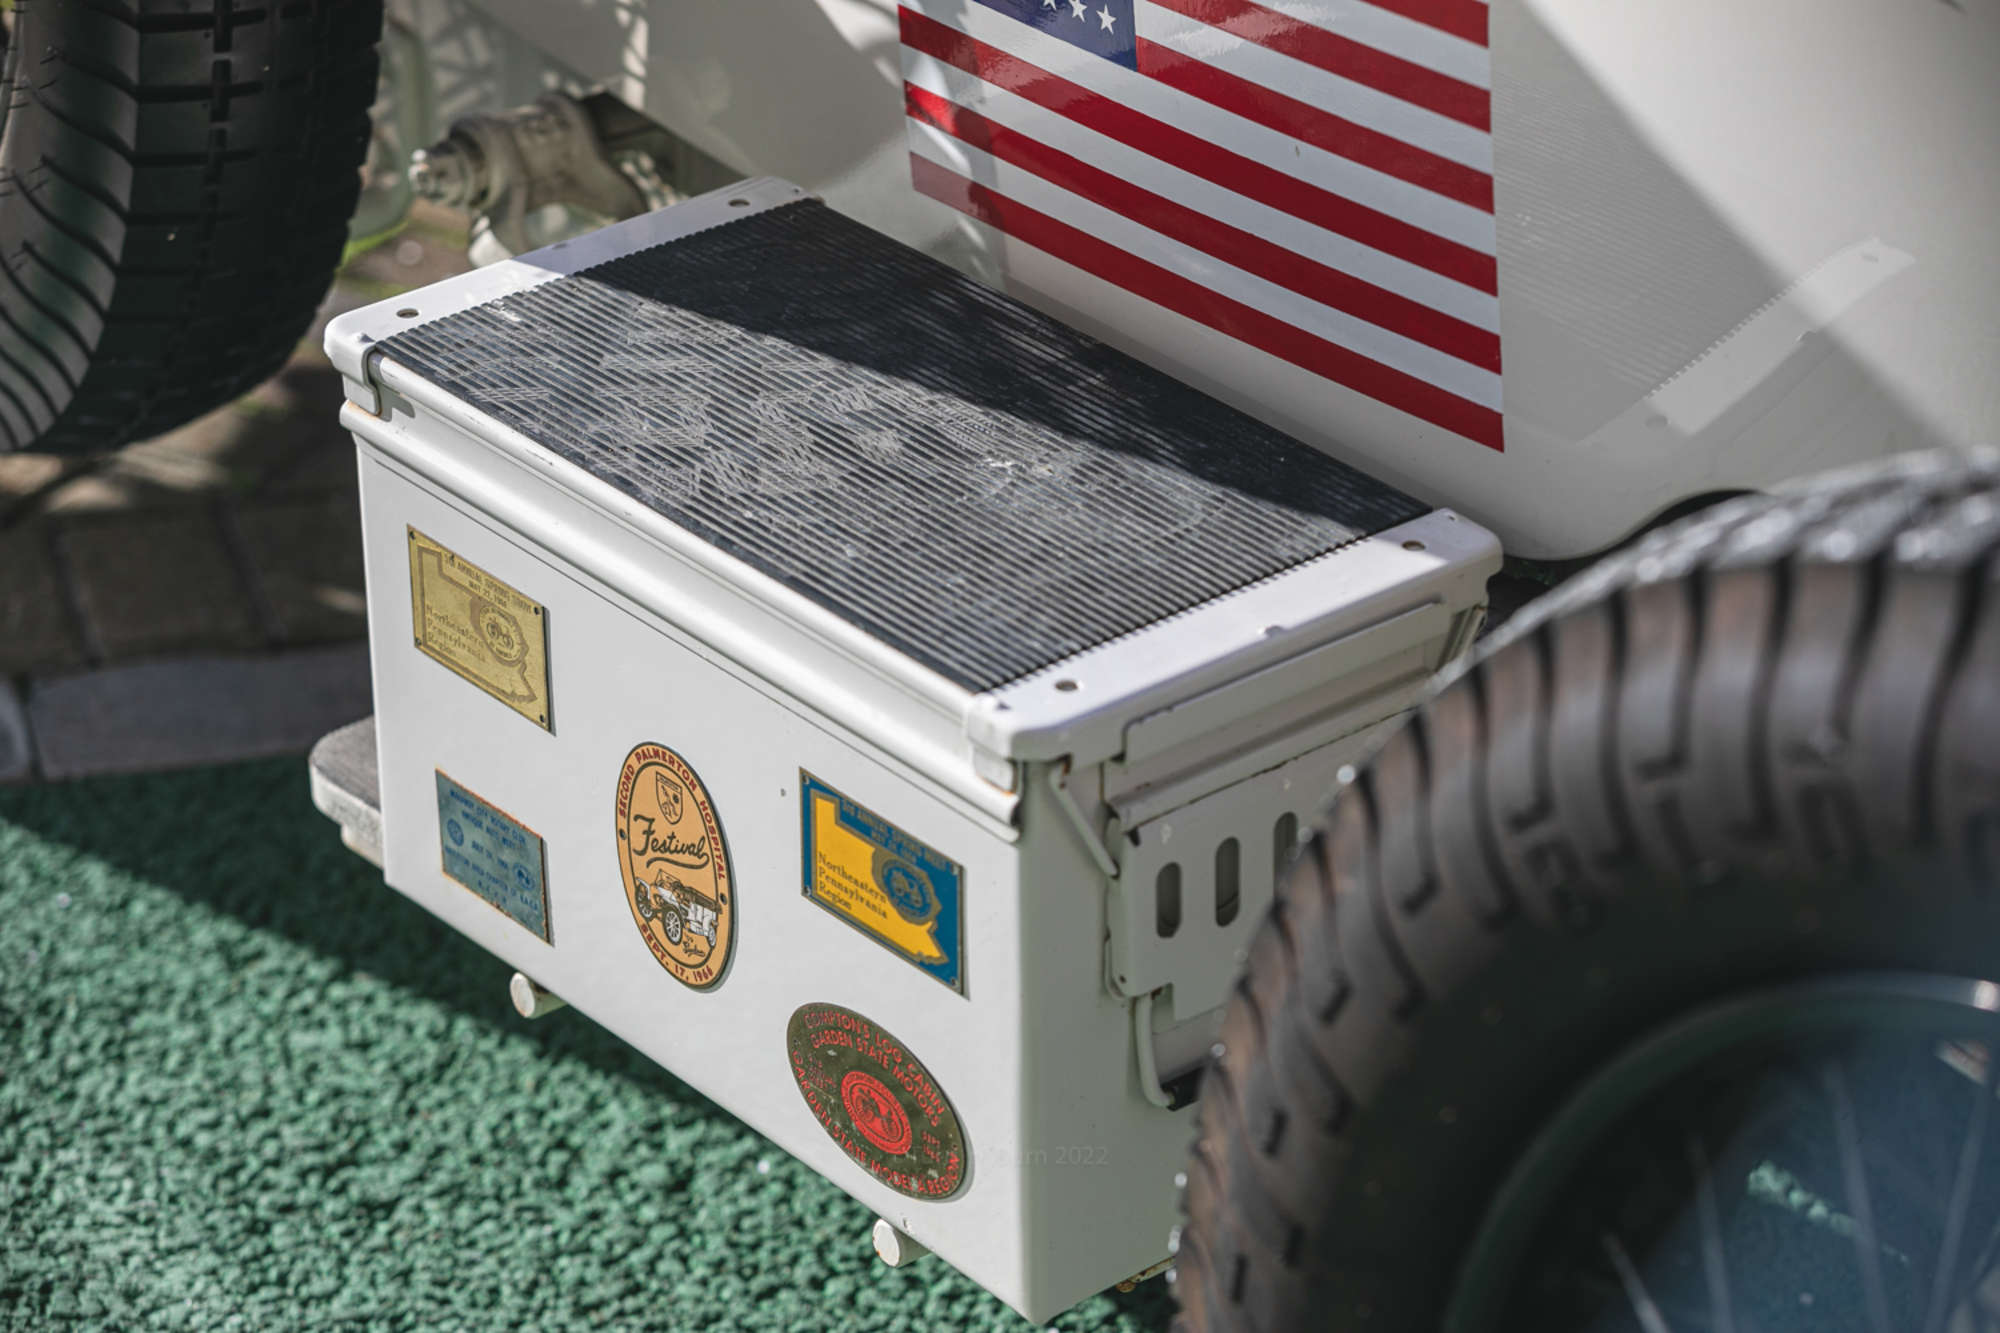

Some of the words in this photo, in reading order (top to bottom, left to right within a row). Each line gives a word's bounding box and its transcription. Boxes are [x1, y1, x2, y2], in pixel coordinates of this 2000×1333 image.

[618, 763, 635, 819] SECOND
[634, 746, 697, 792] PALMERTON
[699, 799, 726, 881] HOSPITAL
[632, 814, 710, 862] Festival
[818, 851, 888, 902] Northeastern
[819, 868, 889, 919] Pennsylvania
[819, 880, 852, 911] Region
[809, 1029, 854, 1049] GARDEN
[855, 1037, 889, 1070] STATE
[891, 1065, 941, 1128] MOTORS
[875, 1031, 903, 1064] LOG
[906, 1063, 946, 1116] CABIN
[792, 1050, 832, 1127] GARDEN
[832, 1125, 867, 1164] STATE
[926, 1151, 961, 1195] REGION
